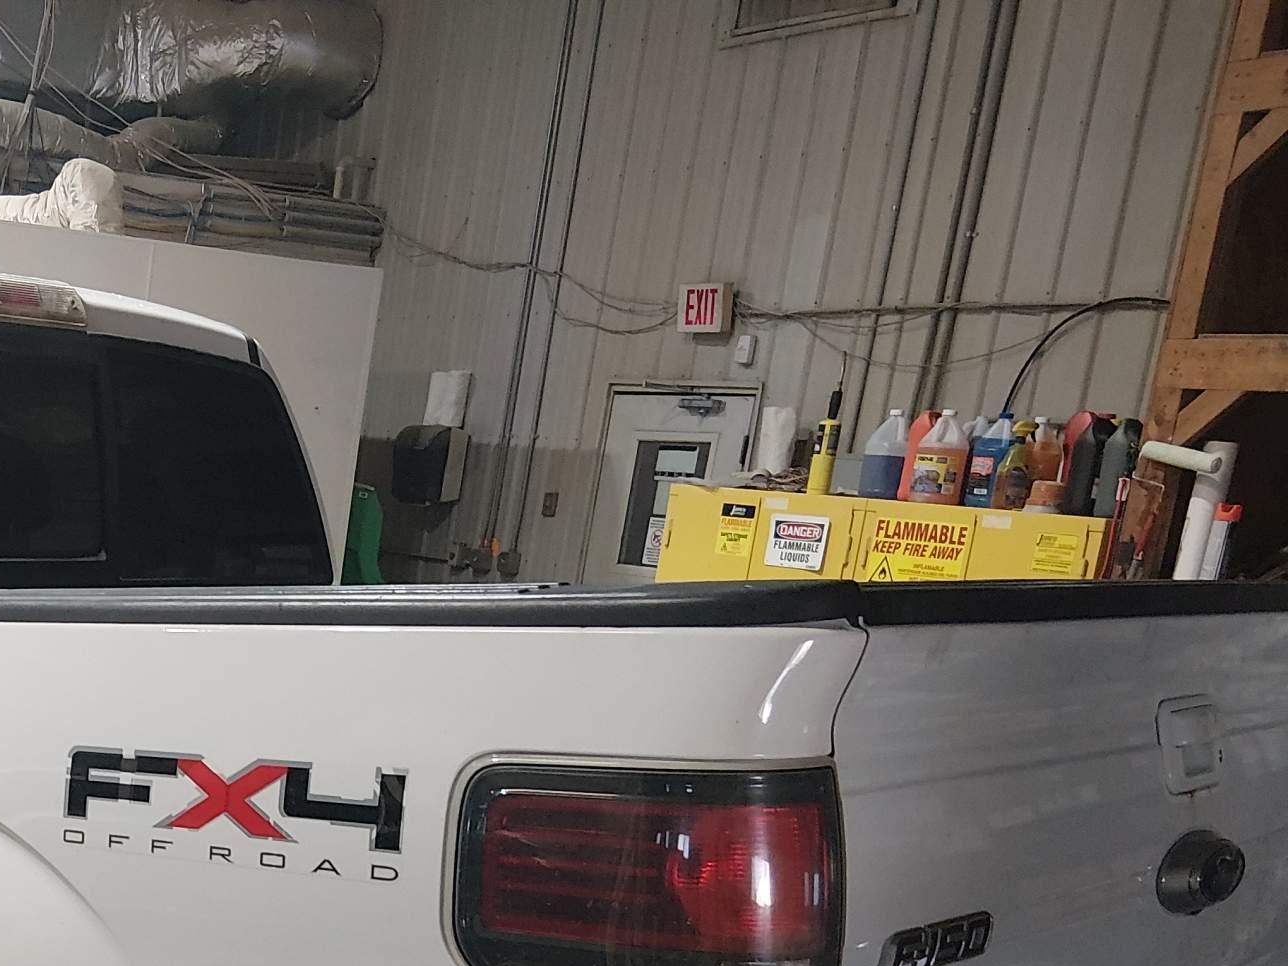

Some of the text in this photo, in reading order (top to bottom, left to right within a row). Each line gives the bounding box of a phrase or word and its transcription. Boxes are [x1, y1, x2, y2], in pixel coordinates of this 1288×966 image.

[685, 288, 718, 325] EXIT
[779, 524, 820, 538] DANGER
[875, 519, 969, 546] FLAMMABLE
[773, 540, 820, 553] FLAMMABLE
[779, 551, 811, 564] LIQUIDS
[872, 539, 964, 561] KEEP FIRE AWAY
[63, 745, 409, 854] FX4
[63, 829, 400, 882] OFF ROAD
